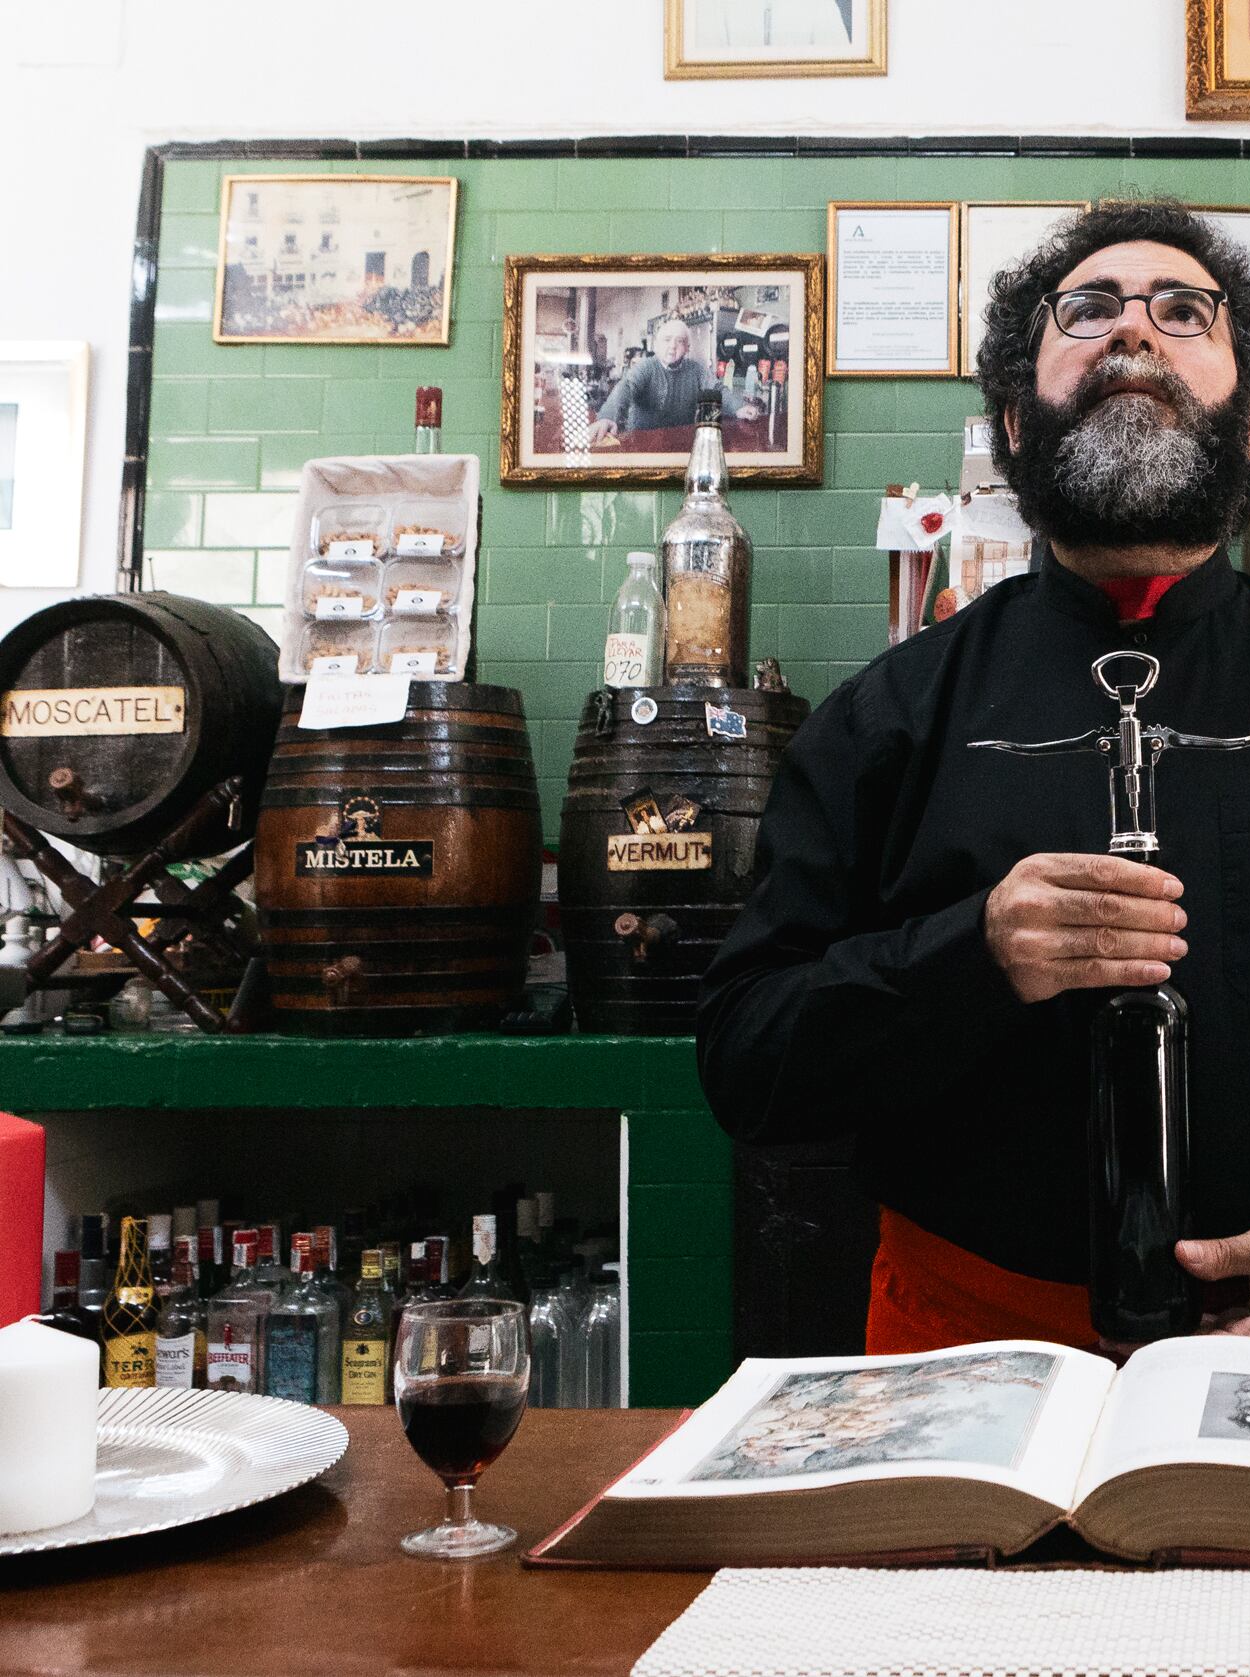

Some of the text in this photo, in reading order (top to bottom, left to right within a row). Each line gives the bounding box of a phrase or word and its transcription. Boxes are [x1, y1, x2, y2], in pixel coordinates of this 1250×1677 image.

[7, 697, 172, 724] MOSCATEL
[305, 849, 420, 868] MISTELA
[615, 842, 704, 862] VERMUT
[156, 1348, 190, 1359] ewar's
[208, 1353, 249, 1364] BEEFEATER
